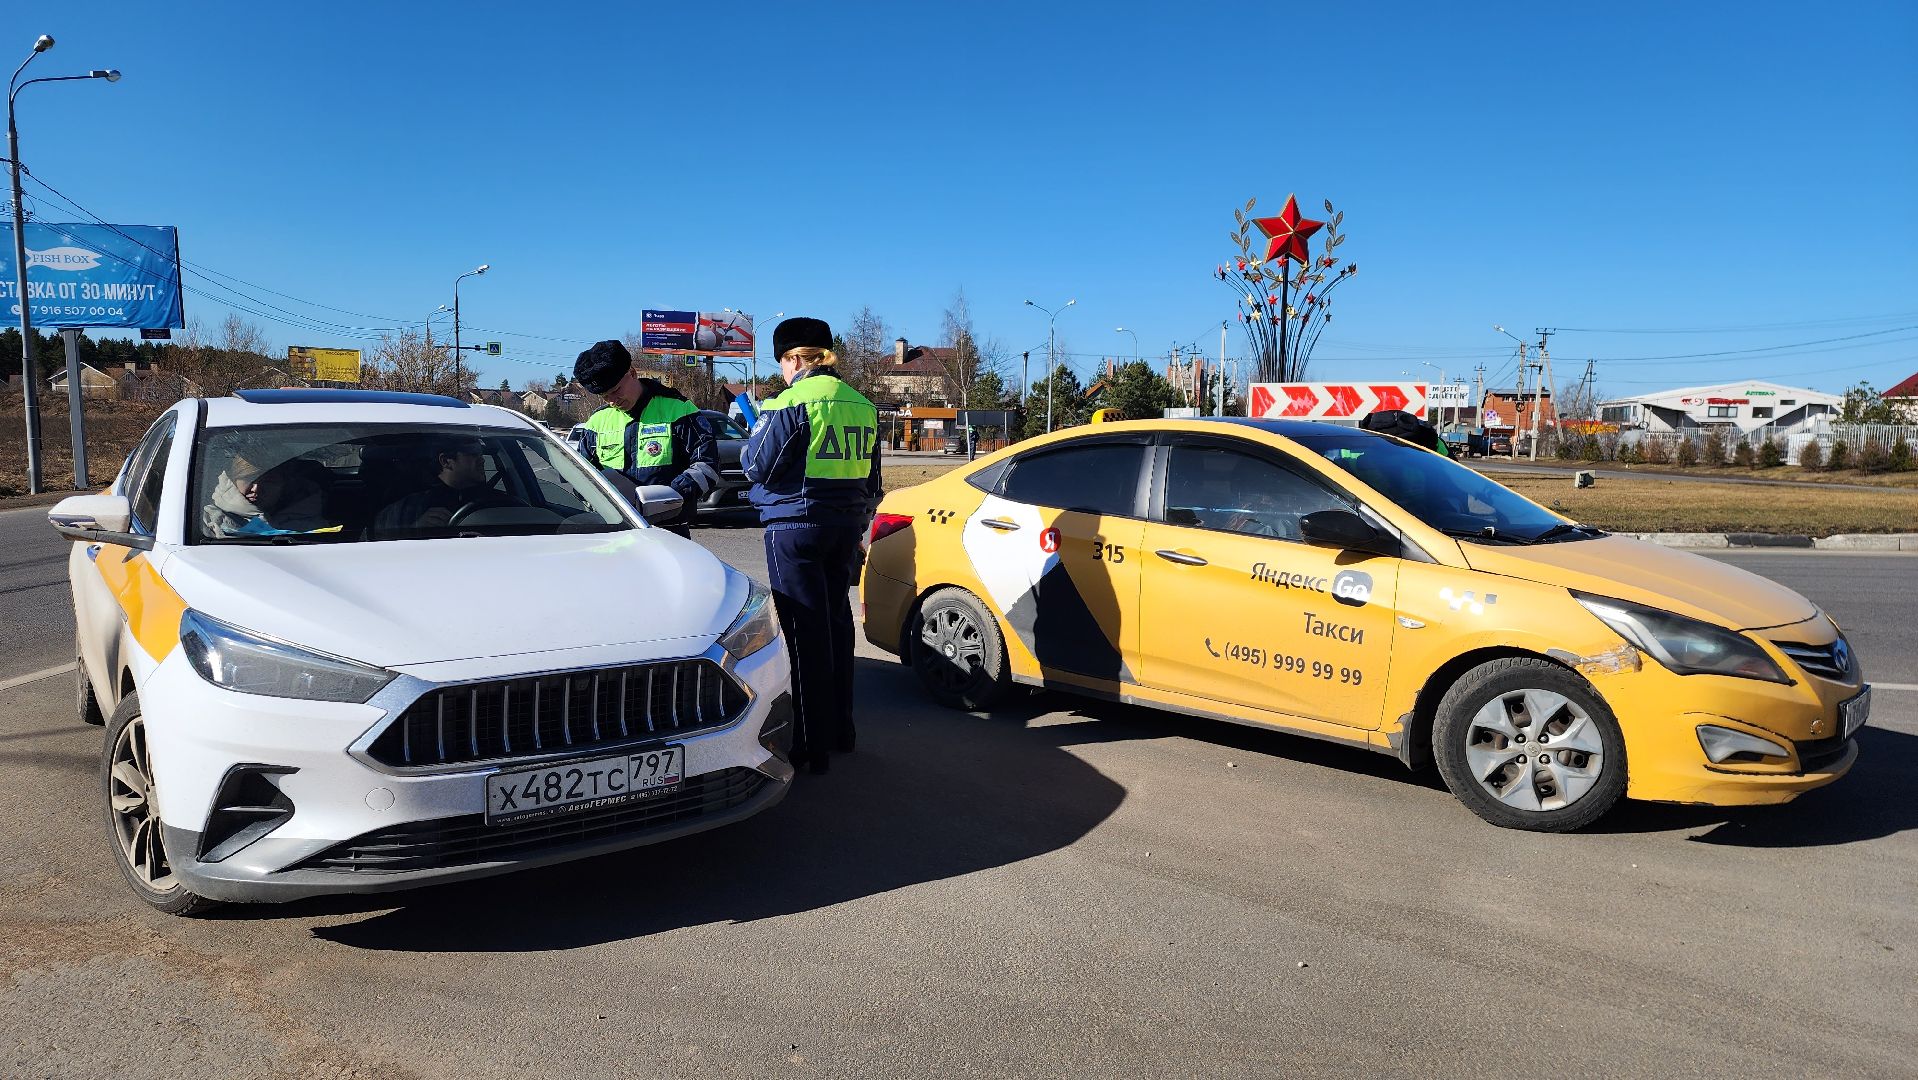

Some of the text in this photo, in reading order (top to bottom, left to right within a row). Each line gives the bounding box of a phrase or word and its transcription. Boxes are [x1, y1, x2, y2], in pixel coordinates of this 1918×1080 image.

[33, 254, 90, 264] FISH BOX
[0, 281, 155, 301] СТВКА ОТ 30 МИНУТ
[41, 306, 62, 315] 916
[64, 306, 86, 316] 507
[89, 307, 105, 316] 00
[107, 307, 124, 316] 04
[815, 424, 876, 461] ДПС
[1044, 531, 1055, 550] Я
[1092, 541, 1125, 564] 315
[1250, 562, 1370, 602] Яндекс Go
[1303, 611, 1364, 645] Такси
[1224, 641, 1363, 686] (495) 999 99 99
[630, 751, 675, 780] 797
[642, 776, 664, 788] RUS
